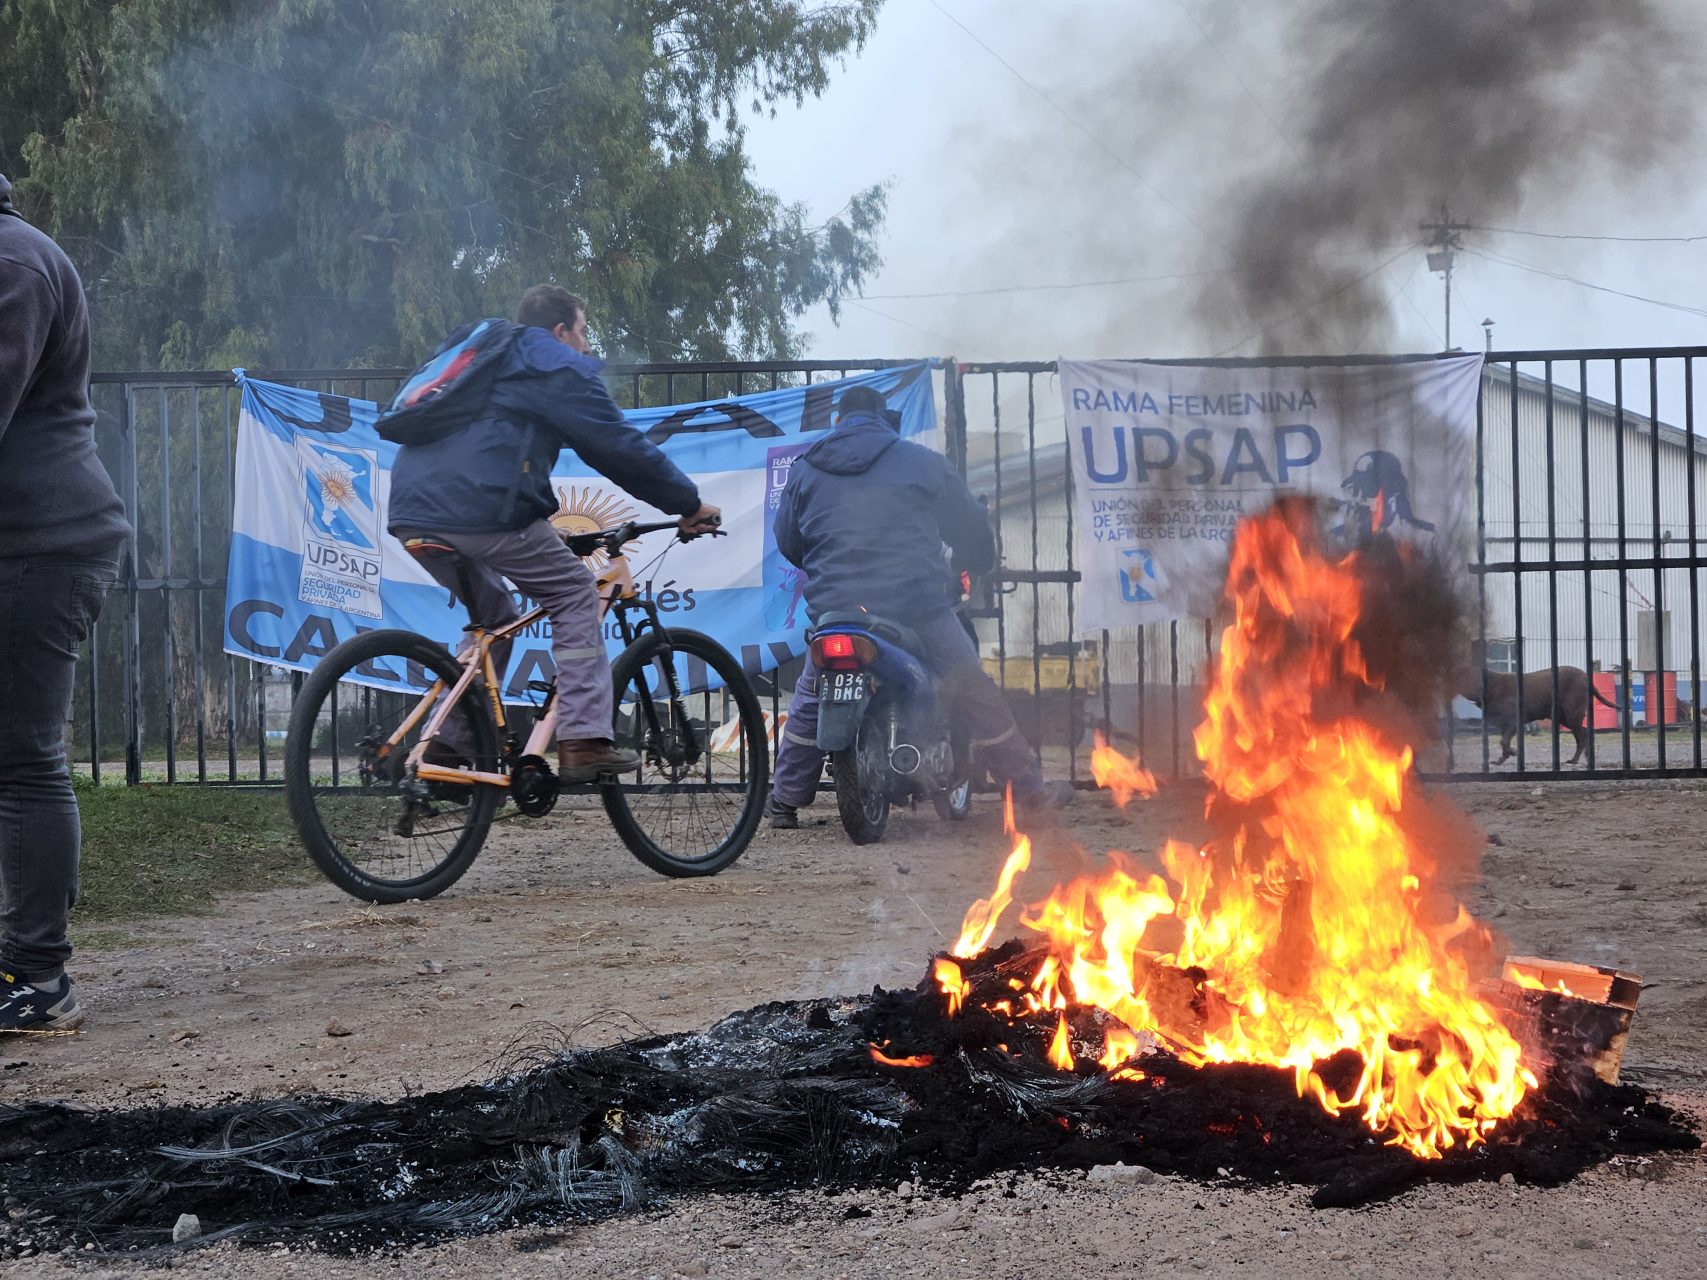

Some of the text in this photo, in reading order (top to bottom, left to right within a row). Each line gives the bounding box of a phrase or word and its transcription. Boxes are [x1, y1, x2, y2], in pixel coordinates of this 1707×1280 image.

[1072, 388, 1317, 416] RAMA FEMENINA
[1081, 424, 1322, 485] UPSAP
[1091, 497, 1140, 512] UNIÓN
[1169, 499, 1244, 512] PERSONAL
[1093, 515, 1112, 528] DE
[1094, 530, 1104, 543] Y
[1157, 527, 1176, 539] DE
[1179, 527, 1198, 539] LA
[307, 543, 379, 580] UPSAP
[302, 587, 346, 605] PRIVADA
[303, 577, 361, 599] SEGURIDAD
[344, 606, 381, 619] ARGENTINA
